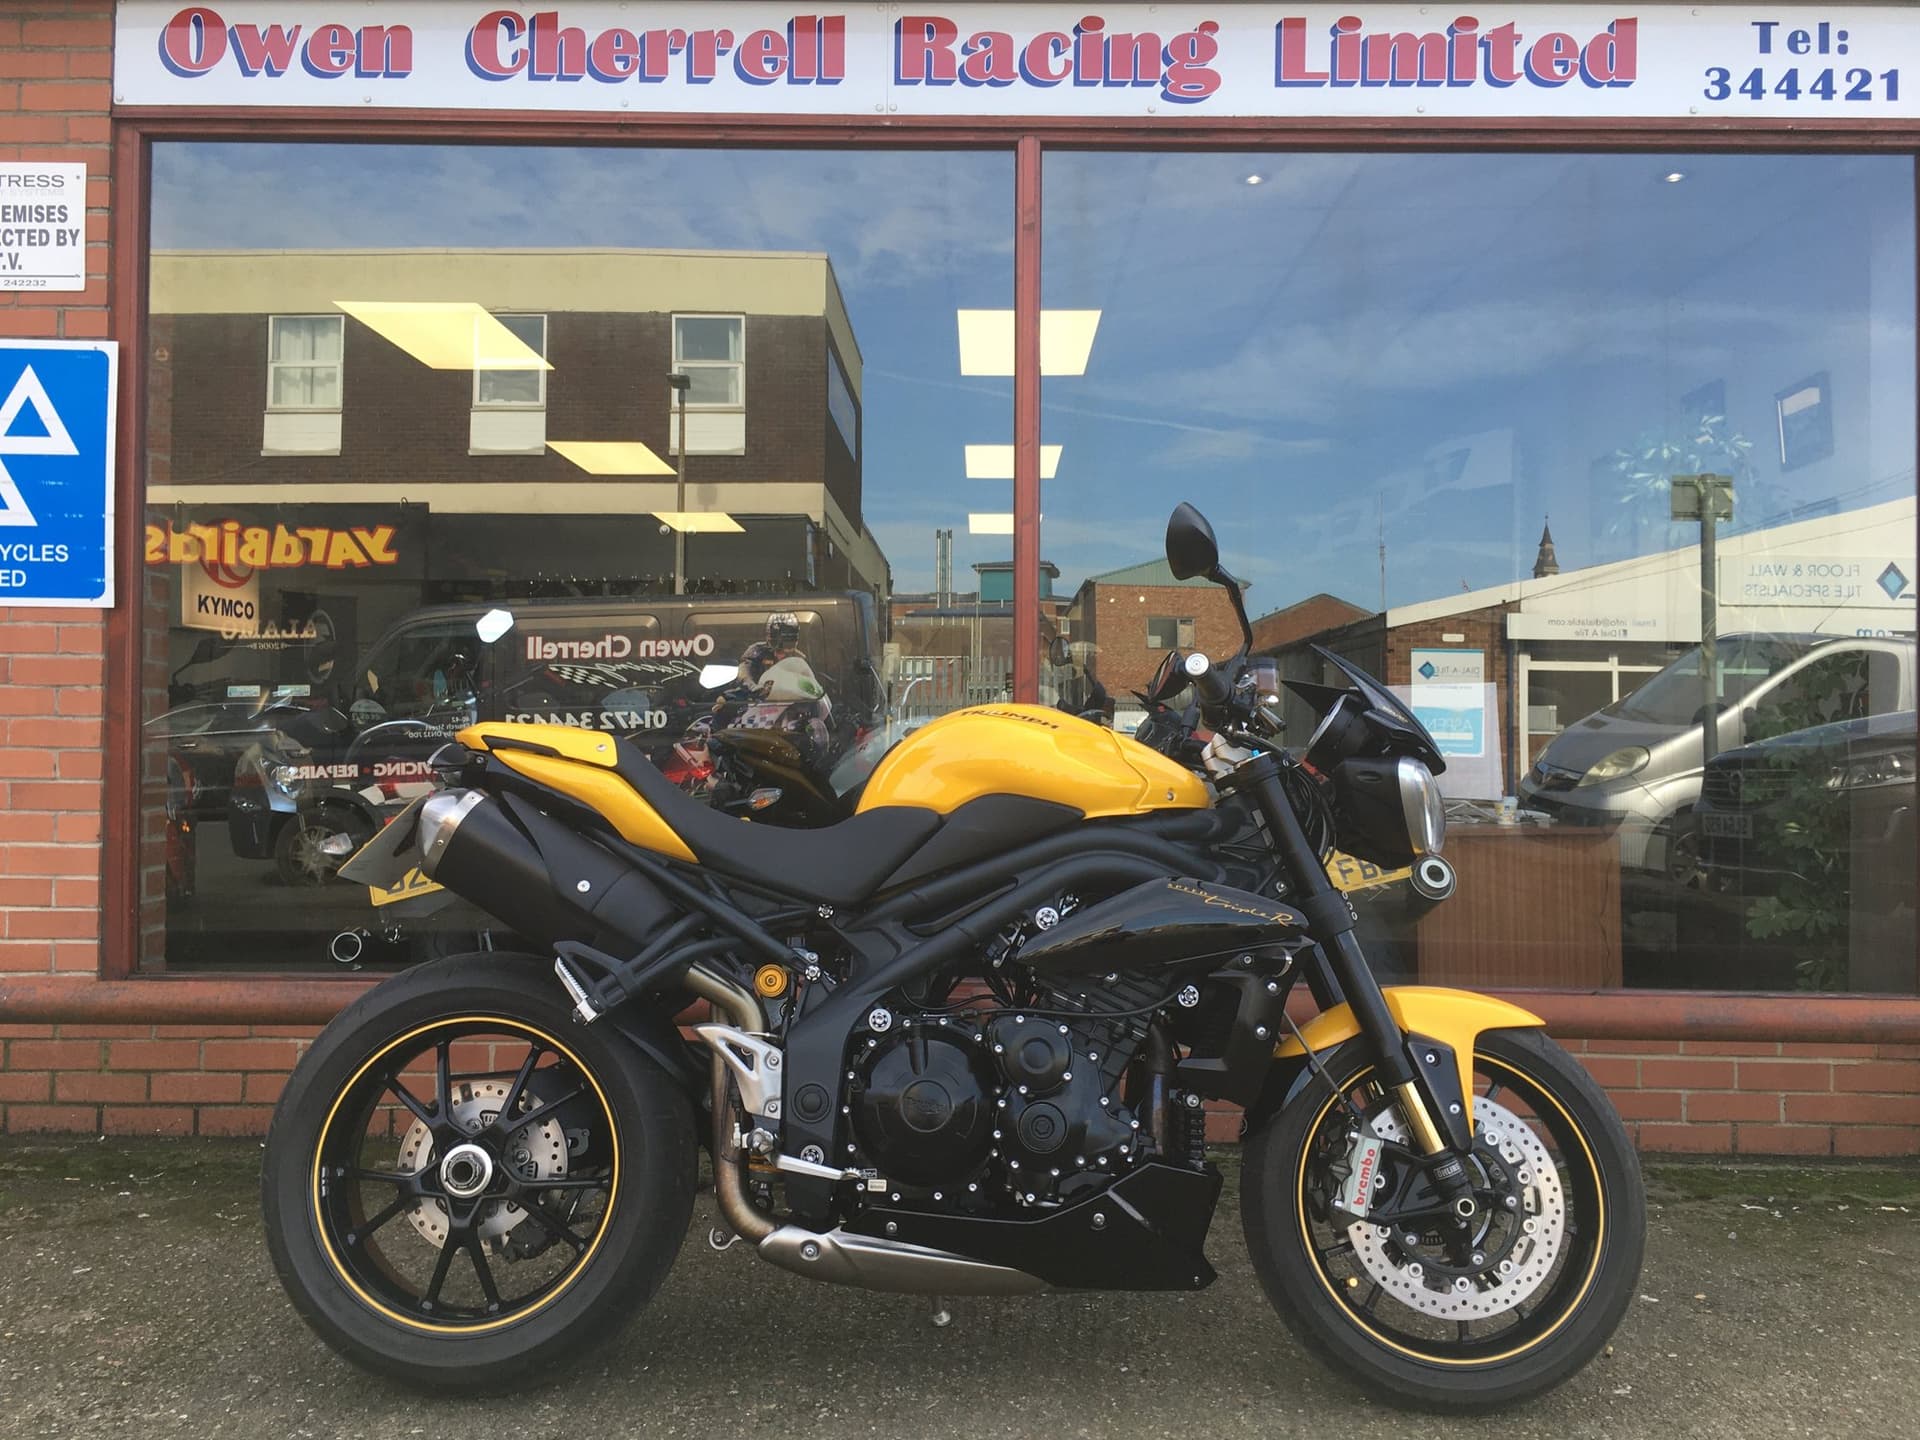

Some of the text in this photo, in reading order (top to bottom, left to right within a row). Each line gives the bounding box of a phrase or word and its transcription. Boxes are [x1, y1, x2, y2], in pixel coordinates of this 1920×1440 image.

[1751, 21, 1850, 56] Tel:
[158, 7, 1638, 104] Owen Cherrell Racing Limited
[1703, 66, 1900, 101] 344421
[0, 229, 81, 247] CTED BY
[3, 279, 47, 287] 242232
[197, 594, 255, 620] KYMCO
[960, 709, 1060, 730] TRIUMPH
[1352, 1148, 1376, 1206] brembo
